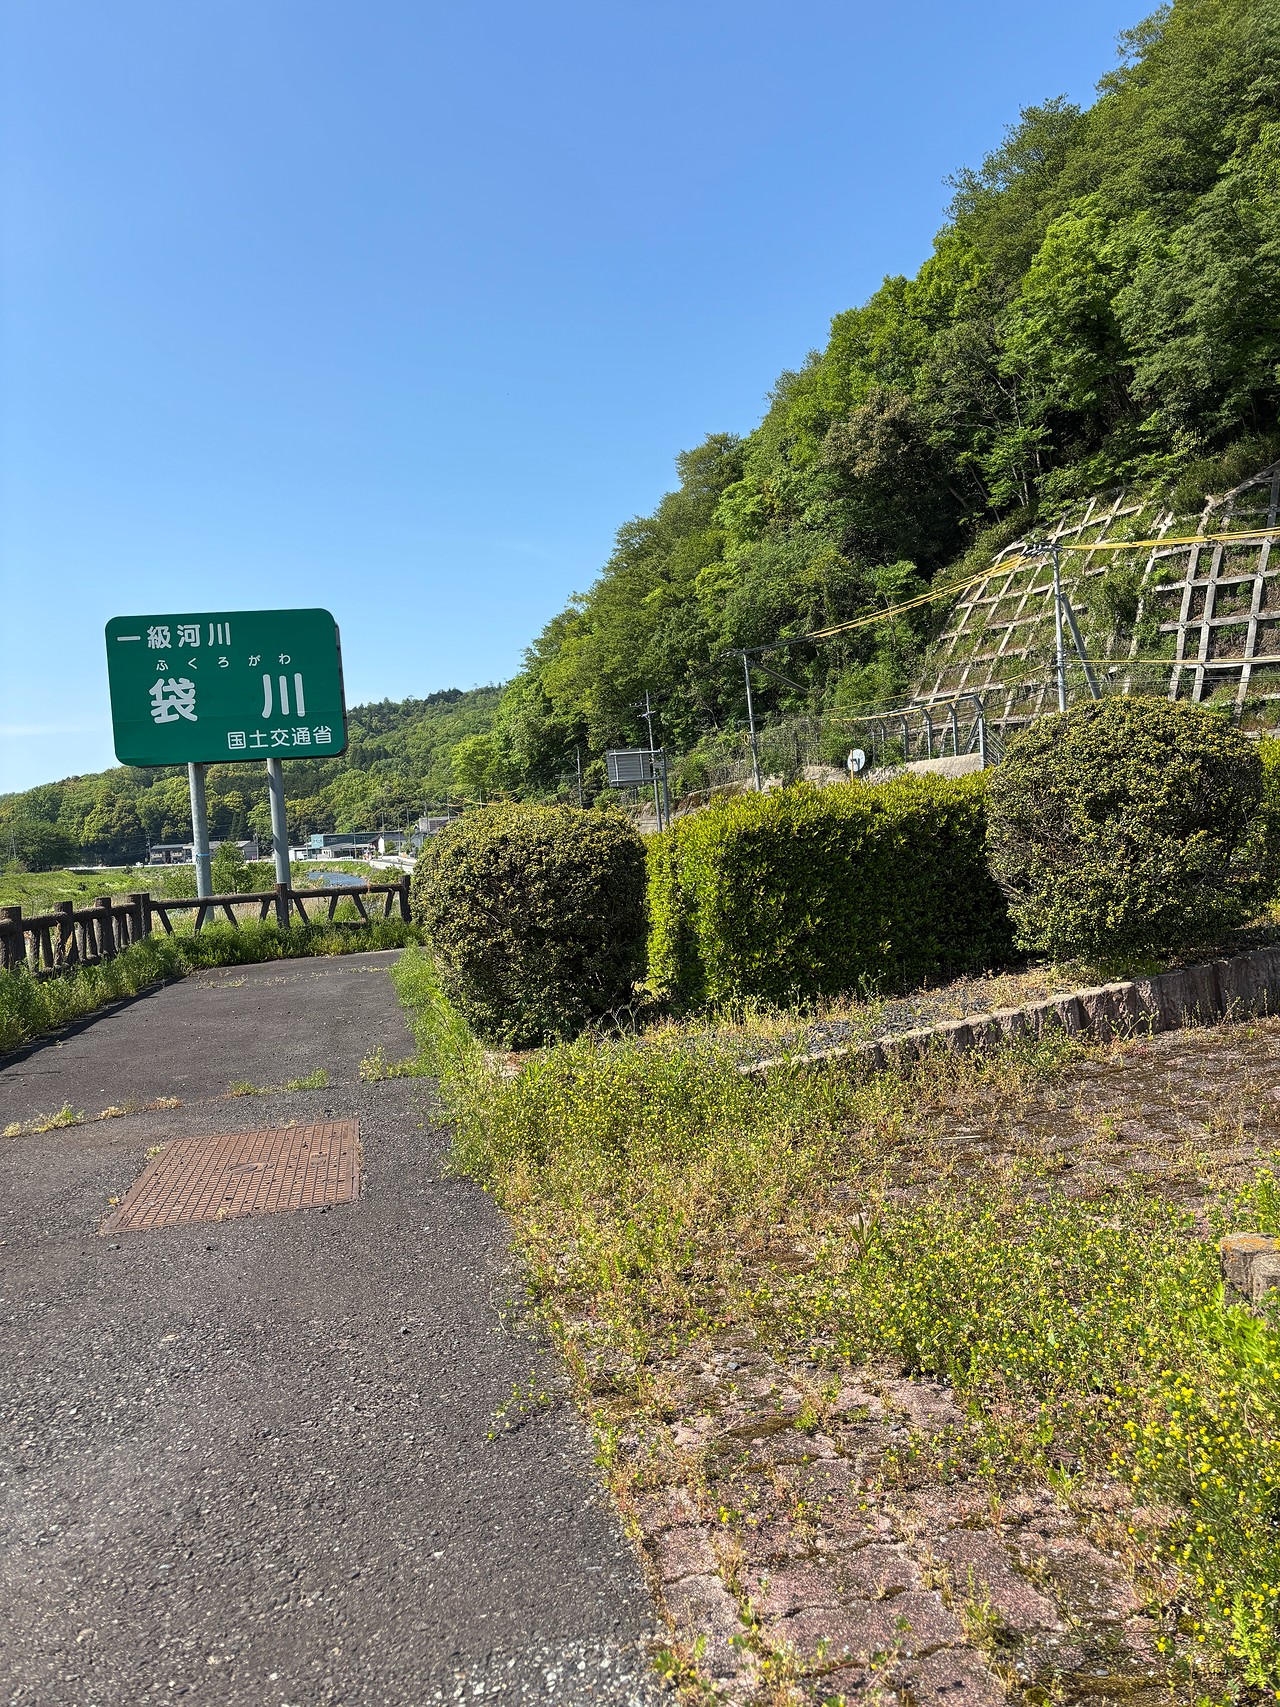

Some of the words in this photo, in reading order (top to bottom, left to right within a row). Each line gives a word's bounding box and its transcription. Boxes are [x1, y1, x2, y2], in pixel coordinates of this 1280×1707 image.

[117, 622, 231, 650] 一級河川
[156, 653, 291, 671] ふくろがわ
[227, 725, 332, 750] 国土交通省
